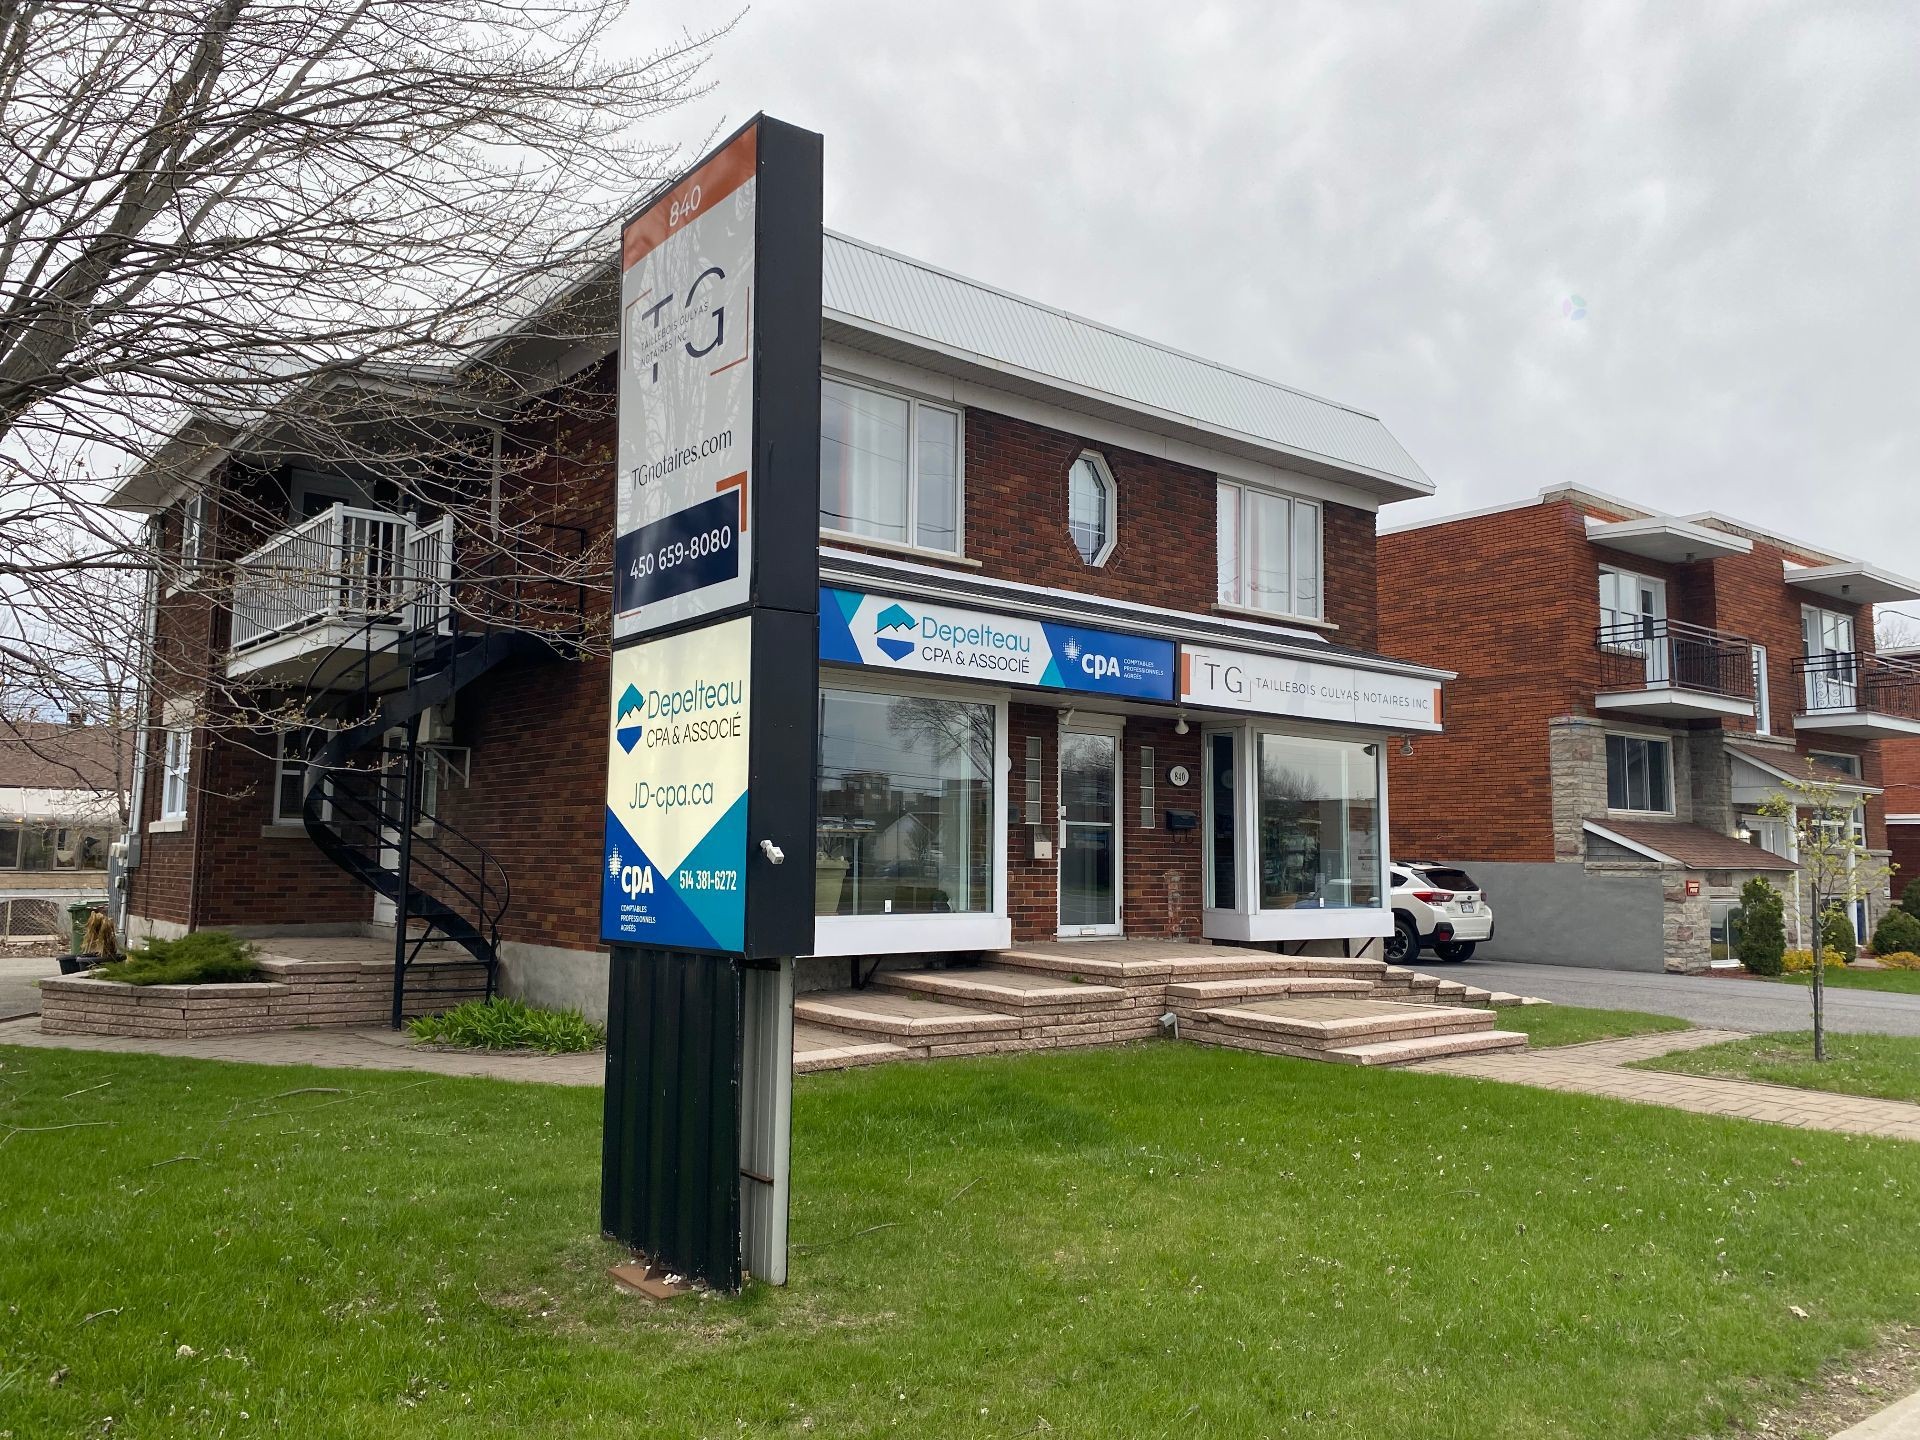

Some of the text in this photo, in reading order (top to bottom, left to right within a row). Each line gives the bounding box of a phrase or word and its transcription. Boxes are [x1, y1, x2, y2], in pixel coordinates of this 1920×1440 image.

[669, 185, 702, 227] 840
[632, 429, 732, 491] TGnotaires.com
[630, 525, 731, 580] 450 659-8080
[922, 616, 1031, 653] Depelteau
[921, 646, 1031, 674] CPA & ASSOCIÉ
[1123, 658, 1155, 668] COMPTABLES
[1123, 665, 1165, 676] PROFESSIONNELS
[1204, 662, 1243, 694] TG
[1256, 677, 1317, 696] TAILLEBOIS
[1320, 686, 1360, 702] GULYAS
[1363, 691, 1410, 707] NOTAIRES
[647, 679, 742, 723] Depelteau
[646, 712, 742, 748] CPA & ASSOCIÉ
[1174, 771, 1186, 782] 840
[629, 781, 714, 815] JD-cpa.ca
[679, 870, 737, 891] 514 381-6272
[620, 904, 648, 913] COMPTABLES
[620, 914, 656, 924] PROFESSIONNELS
